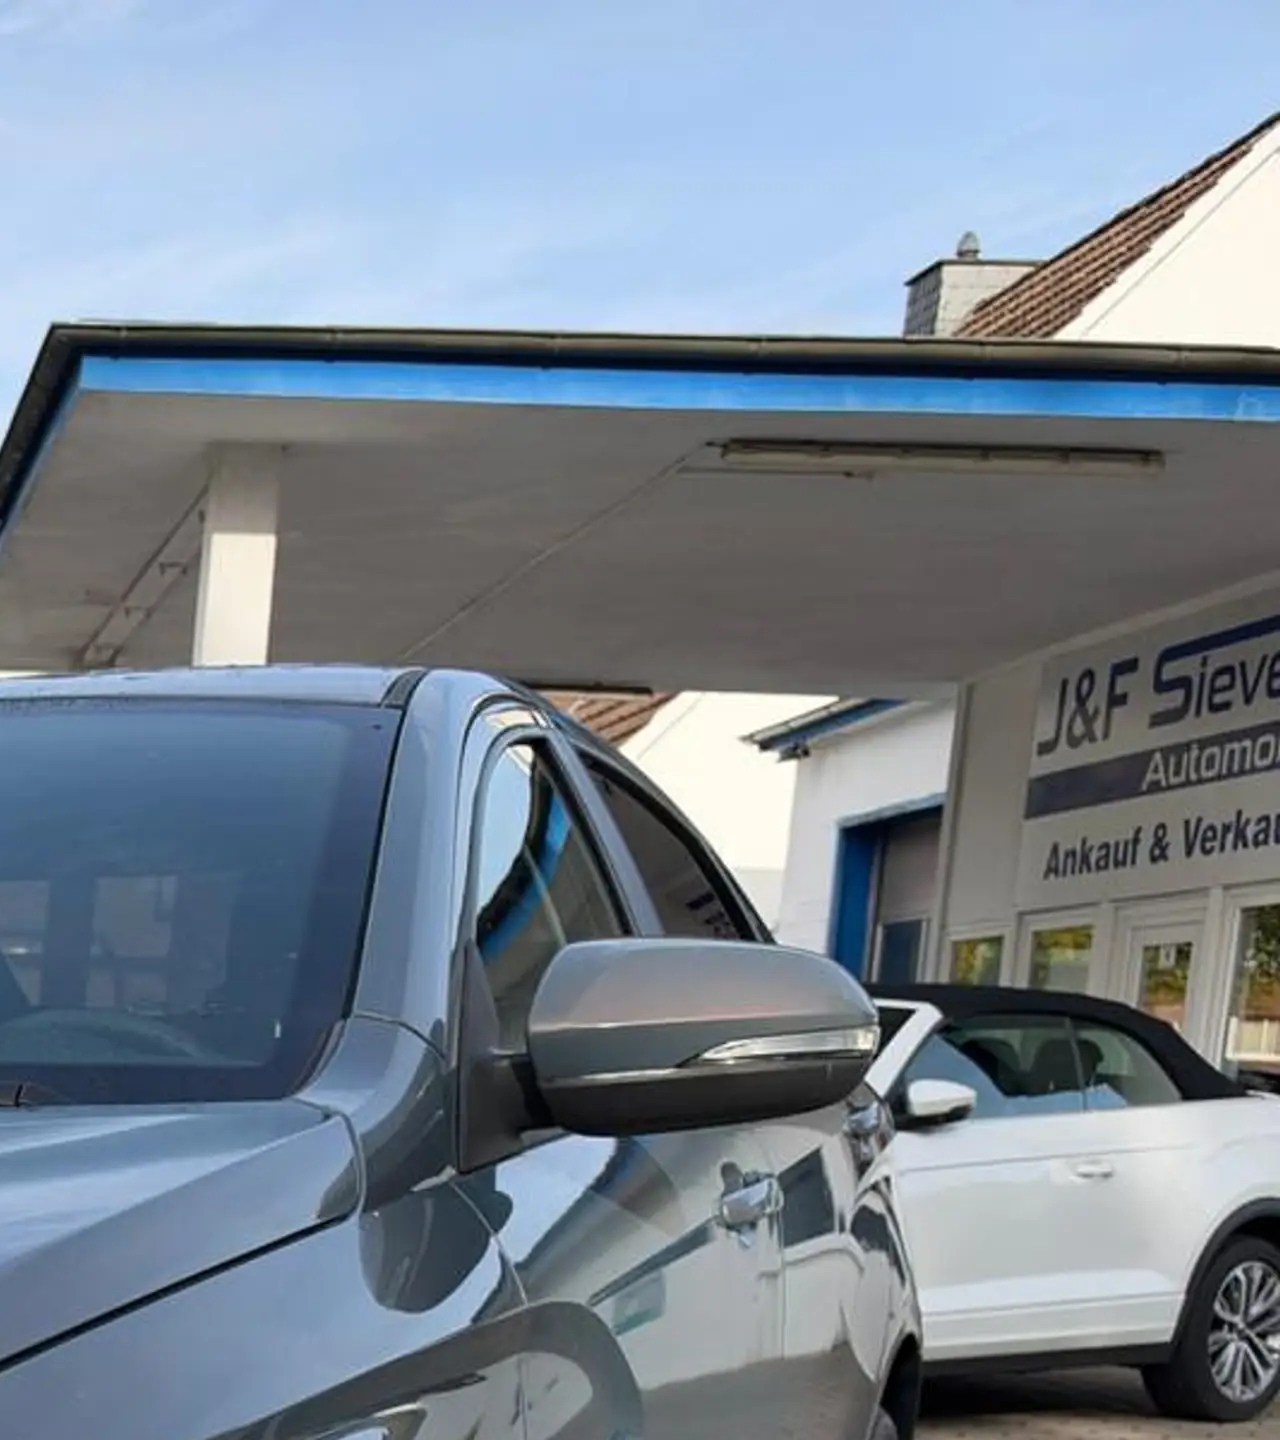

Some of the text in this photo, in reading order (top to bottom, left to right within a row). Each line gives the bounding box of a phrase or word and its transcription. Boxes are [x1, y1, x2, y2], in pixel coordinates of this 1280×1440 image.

[1037, 656, 1139, 757] J&F
[1141, 732, 1280, 791] Automo
[1043, 825, 1143, 881] Ankauf
[1149, 822, 1172, 865] &
